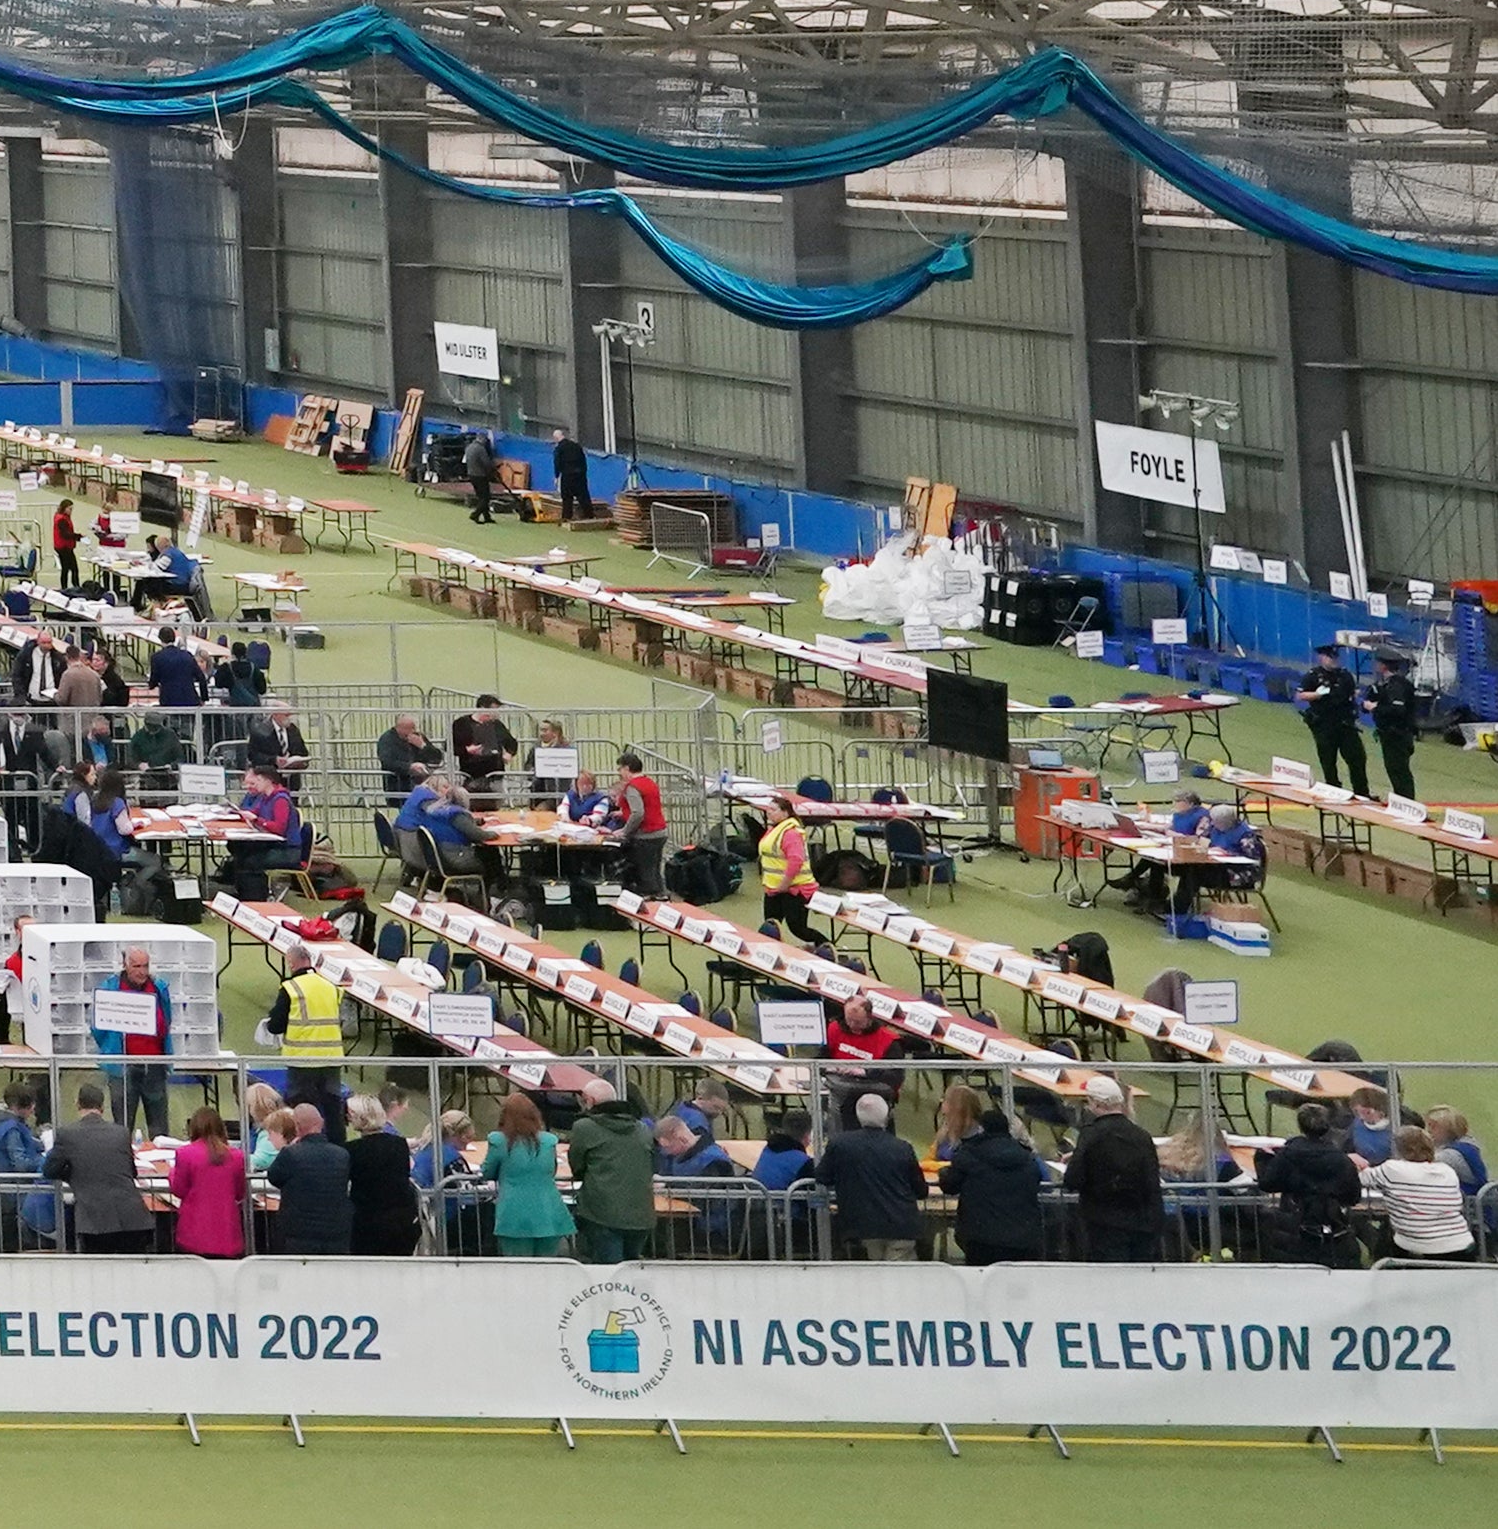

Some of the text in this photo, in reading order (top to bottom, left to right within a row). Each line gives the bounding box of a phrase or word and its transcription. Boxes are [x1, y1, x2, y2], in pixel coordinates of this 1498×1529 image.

[445, 342, 487, 360] MID ULSTER
[1130, 451, 1186, 483] FOYLE
[1447, 813, 1481, 832] SUGDEN
[714, 934, 738, 948] HUNTER
[568, 980, 592, 996] QUIGLEY
[1047, 983, 1078, 999] BRADLEY
[1088, 997, 1116, 1013] BRADLEY
[1135, 1014, 1159, 1029] BRADLEY
[1174, 1027, 1207, 1045] BROLLY
[558, 1282, 672, 1331] THE ELECTORAL OFFICE
[258, 1314, 381, 1360] 2022
[693, 1319, 1456, 1371] NI ASSEMBLY ELECTION 2022
[559, 1347, 673, 1401] FOR NORTHERN IRELAND
